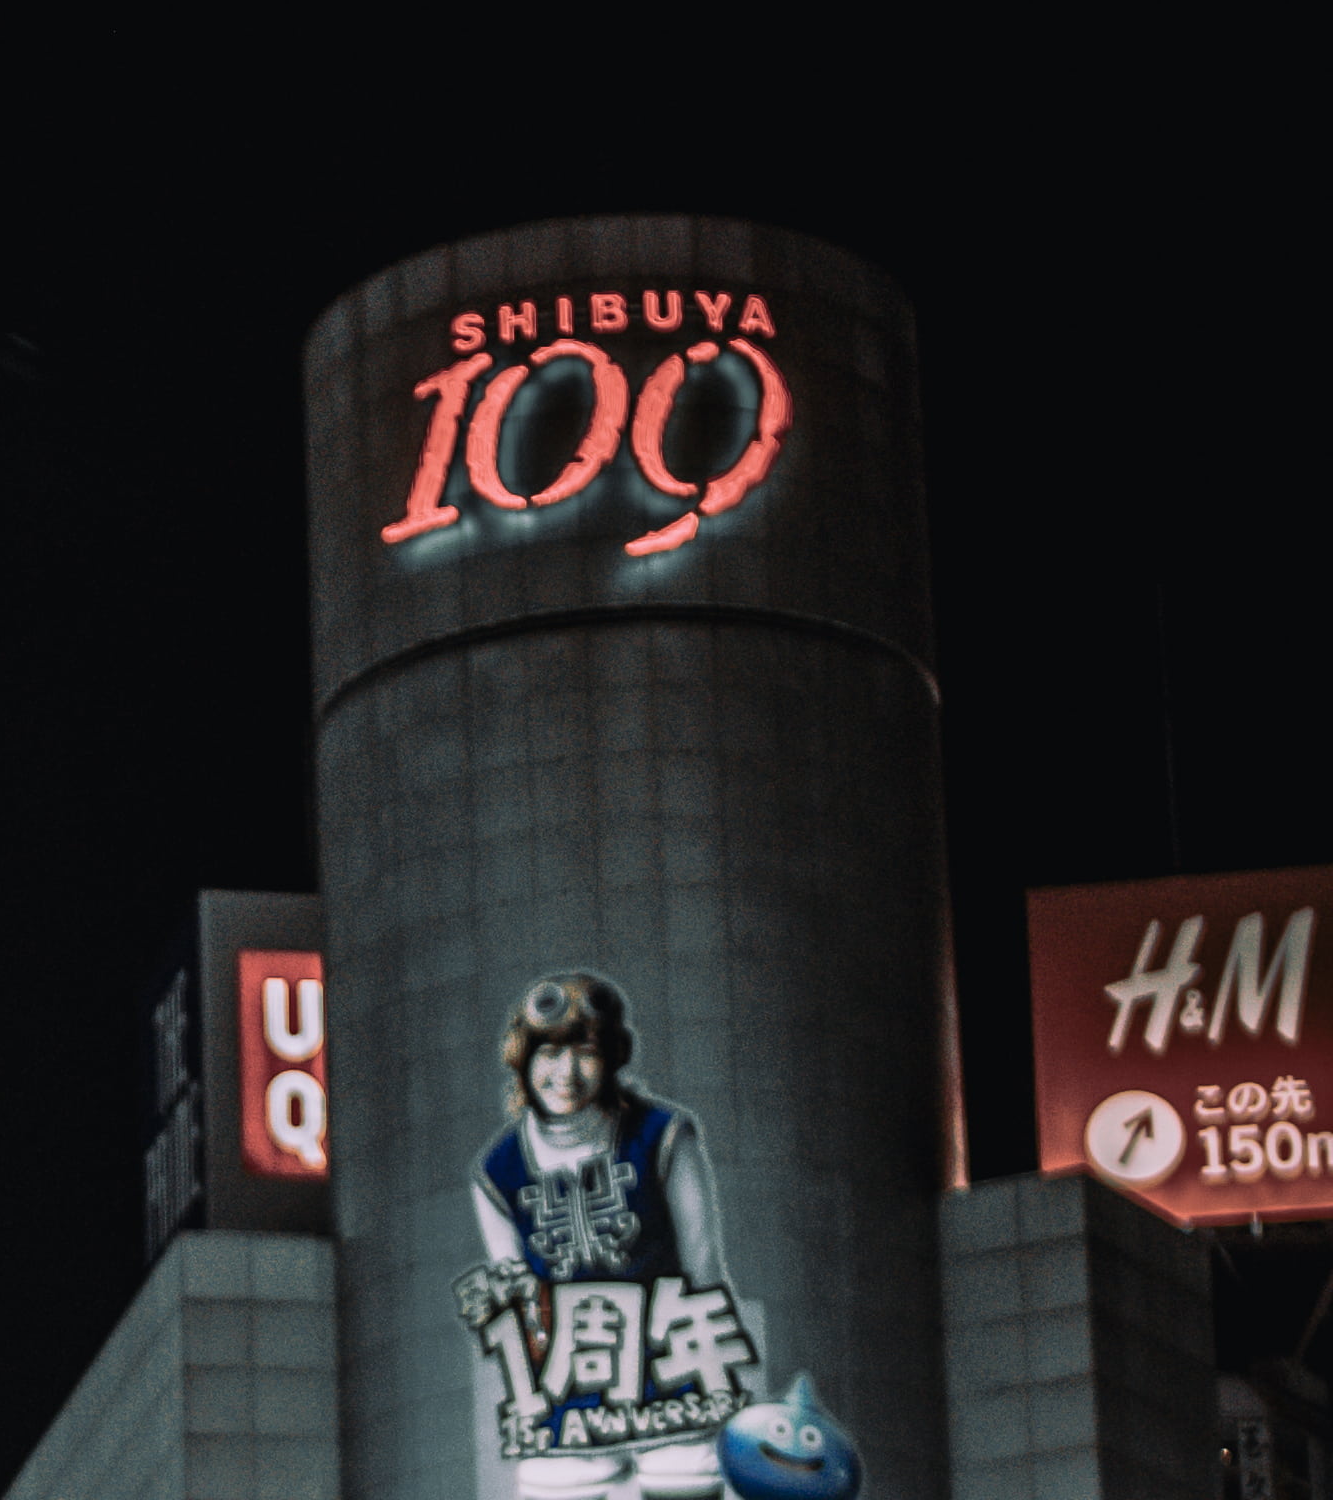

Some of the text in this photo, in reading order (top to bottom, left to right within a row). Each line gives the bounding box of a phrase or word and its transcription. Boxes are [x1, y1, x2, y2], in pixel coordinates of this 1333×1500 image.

[451, 290, 777, 354] SHIBUYA
[381, 337, 794, 556] 109
[1103, 904, 1315, 1058] H&M
[1193, 1073, 1316, 1125] この先
